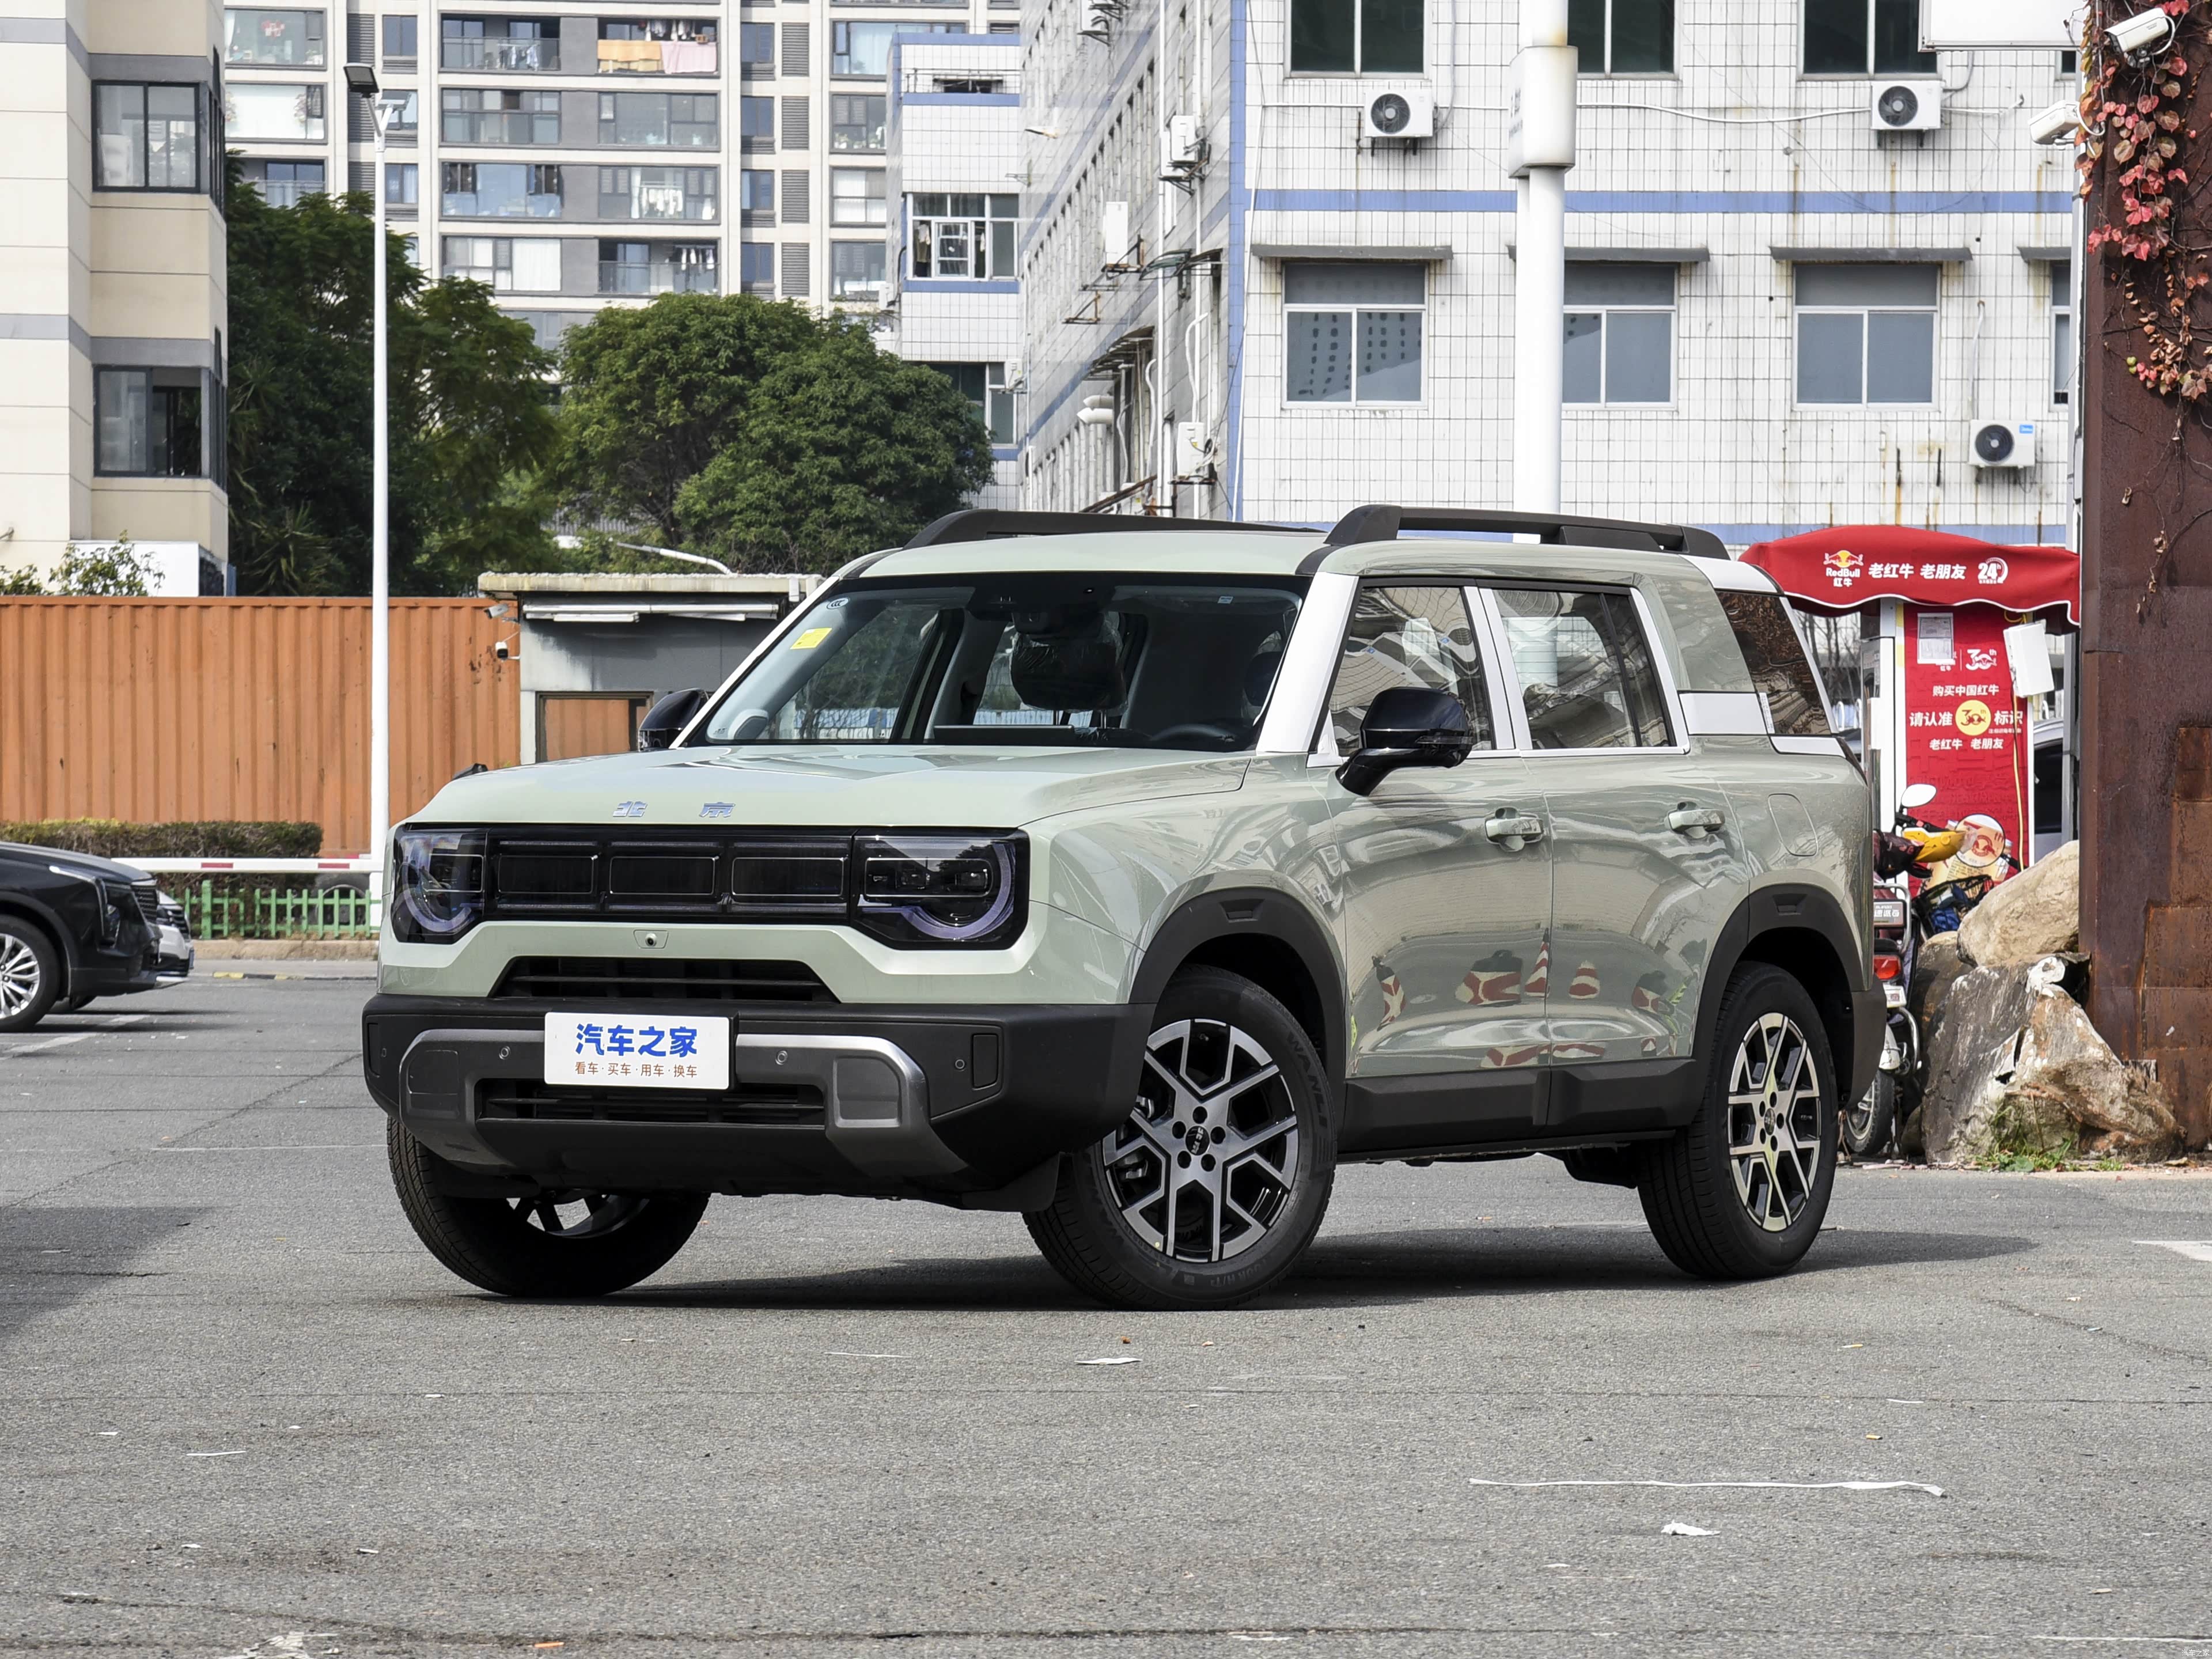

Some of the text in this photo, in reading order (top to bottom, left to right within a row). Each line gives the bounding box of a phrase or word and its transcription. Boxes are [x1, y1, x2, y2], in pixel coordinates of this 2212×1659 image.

[1868, 563, 1967, 580] 老红牛 老朋友
[1834, 577, 1853, 587] 红牛
[1933, 684, 1999, 697] 购买中国红牛
[1909, 711, 1953, 727] 请认准
[1993, 710, 2024, 726] 标识
[1929, 737, 2004, 750] 老红牛 老朋友
[574, 1022, 698, 1058] 汽车之家
[1286, 1031, 1328, 1129] WANLI
